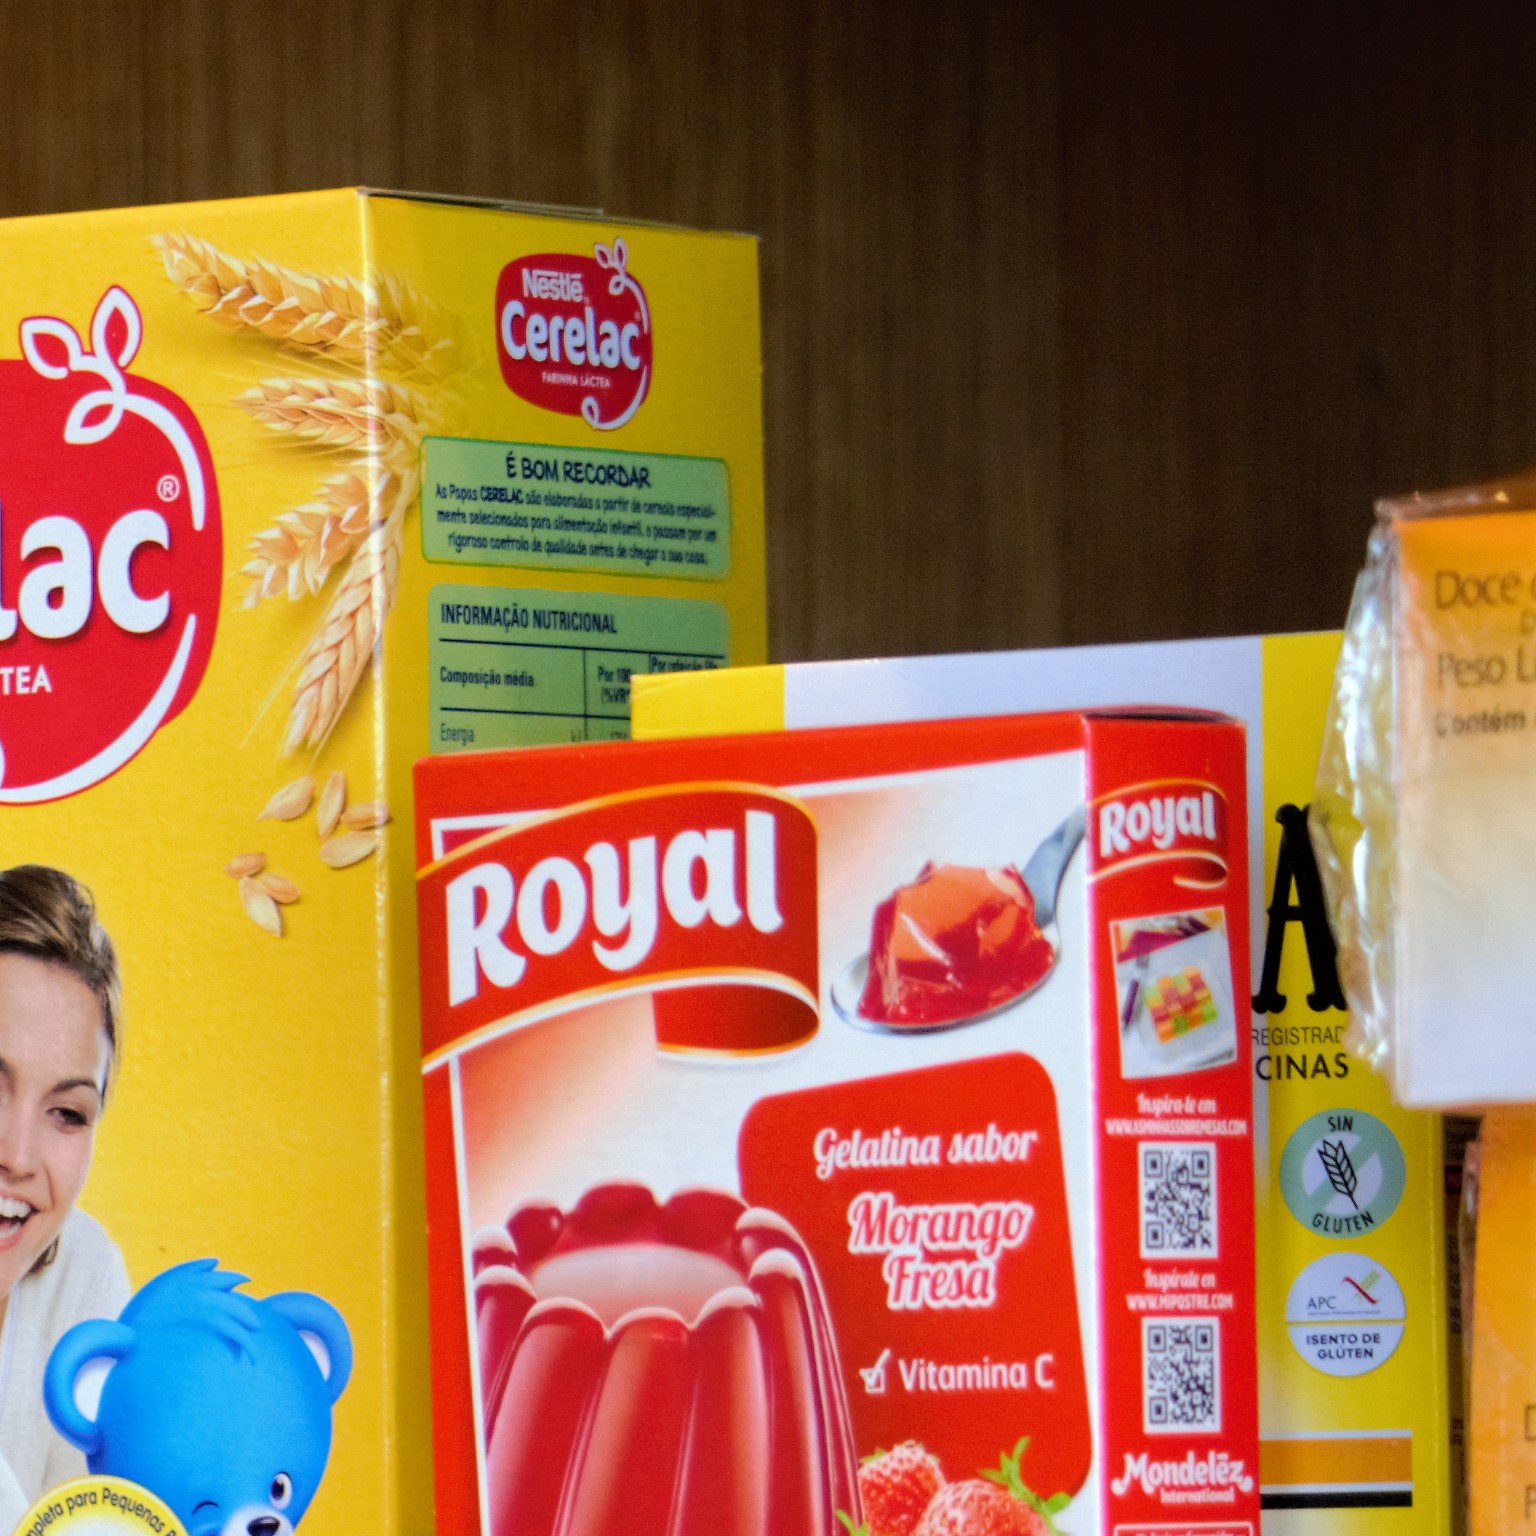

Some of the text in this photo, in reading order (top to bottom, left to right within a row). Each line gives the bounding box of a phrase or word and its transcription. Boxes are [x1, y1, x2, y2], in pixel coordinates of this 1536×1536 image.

[522, 268, 584, 302] Nestlé
[501, 300, 641, 370] Cerelac
[505, 451, 652, 489] É BOM RECORDAR
[480, 486, 523, 505] CERELAC
[1435, 569, 1521, 611] Doce
[441, 604, 617, 634] INFORMAÇÃO NUTRICIONAL
[440, 666, 501, 687] Composição
[1438, 652, 1507, 688] Peso
[1100, 791, 1216, 857] Royal
[444, 809, 784, 1006] Royal
[1254, 1053, 1349, 1080] CINAS
[1328, 1116, 1353, 1132] SIN
[813, 1122, 1038, 1180] Gelatina sabor
[849, 1192, 1034, 1261] Morango
[1312, 1210, 1375, 1233] GLUTEN
[883, 1251, 996, 1310] Fresa
[1307, 1297, 1337, 1310] APC
[1307, 1333, 1381, 1345] ISENTO DE
[898, 1354, 1054, 1392] Vitamina C
[66, 1490, 98, 1515] para
[102, 1487, 166, 1534] Pequenas
